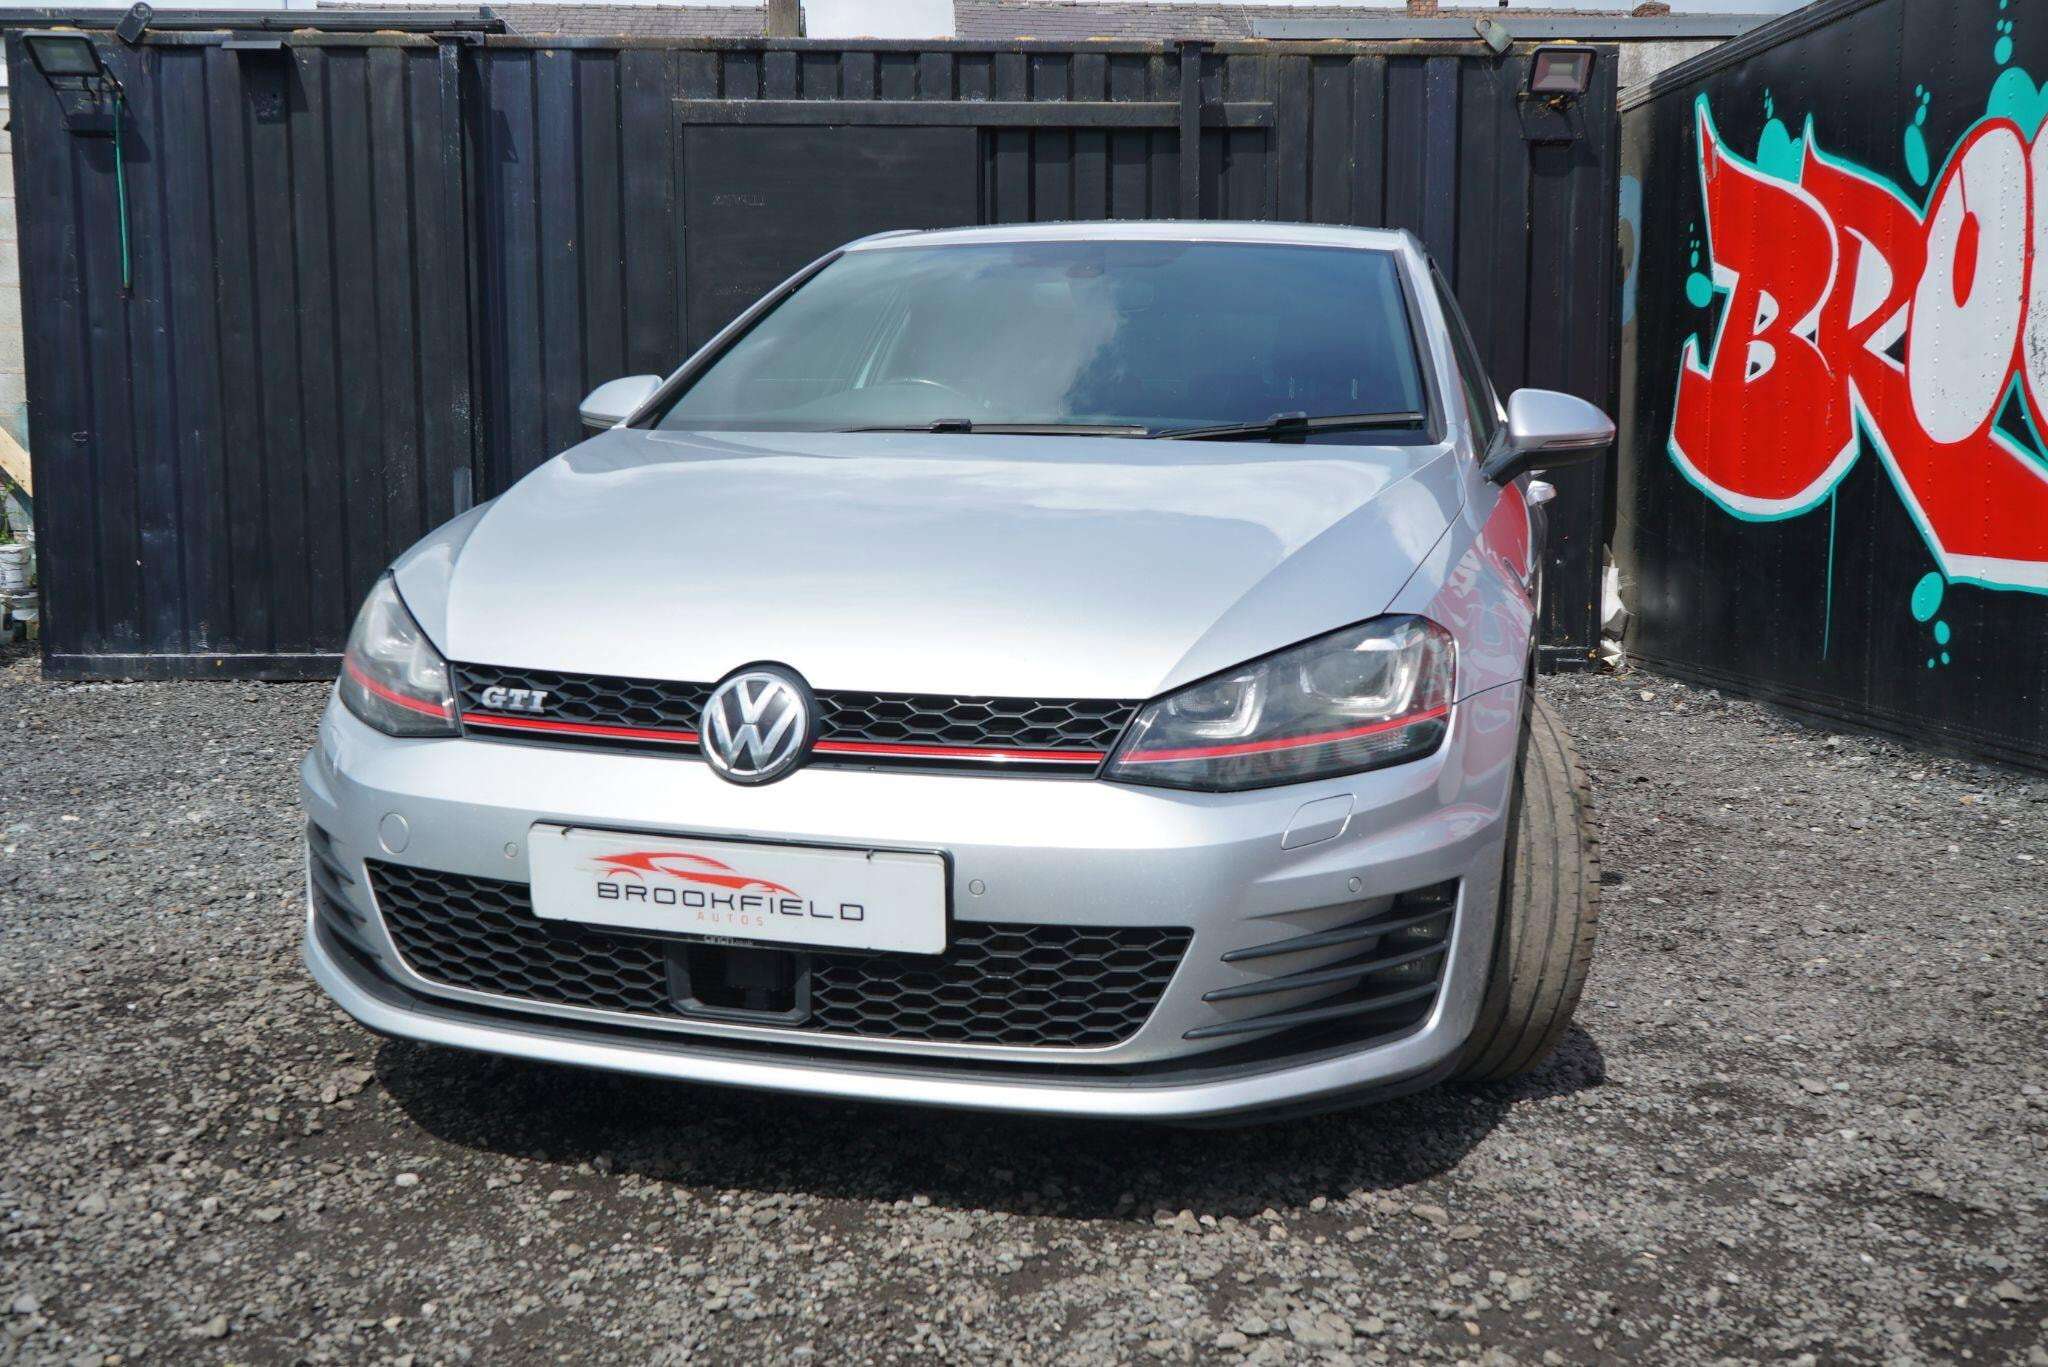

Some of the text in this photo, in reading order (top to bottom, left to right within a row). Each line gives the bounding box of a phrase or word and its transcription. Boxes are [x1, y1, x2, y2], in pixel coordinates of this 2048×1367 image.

[1668, 92, 2048, 595] BRO
[480, 686, 549, 713] GTI
[597, 881, 864, 922] BROOKFIELD
[696, 911, 764, 927] AUTOS
